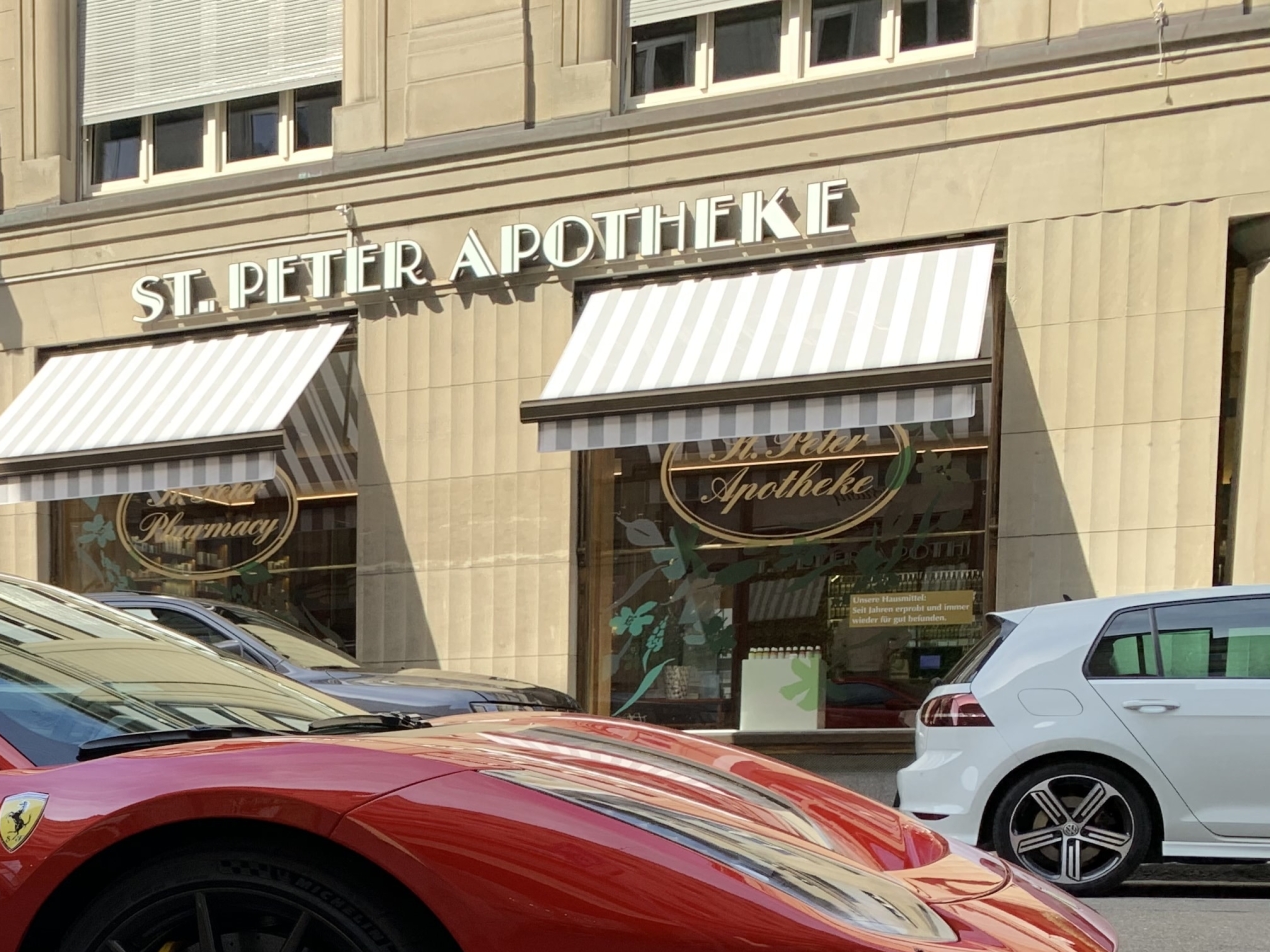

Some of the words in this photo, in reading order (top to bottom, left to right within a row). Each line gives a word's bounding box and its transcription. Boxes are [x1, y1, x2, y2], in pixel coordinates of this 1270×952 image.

[131, 268, 215, 323] ST.
[228, 239, 428, 310] PETER
[449, 179, 851, 282] APOTHEKE
[701, 458, 874, 515] Apotheke
[139, 511, 279, 546] Pharmacy
[852, 595, 880, 604] Unsere
[882, 593, 927, 603] Hausmittel:
[852, 606, 866, 614] Seit
[868, 605, 893, 615] Jahren
[895, 604, 924, 614] erprobt
[926, 603, 942, 611] und
[944, 603, 970, 611] immer
[852, 616, 878, 625] wieder
[880, 615, 892, 623] für
[893, 616, 906, 625] gut
[908, 614, 947, 623] befunden.
[293, 873, 386, 947] MICHELIN
